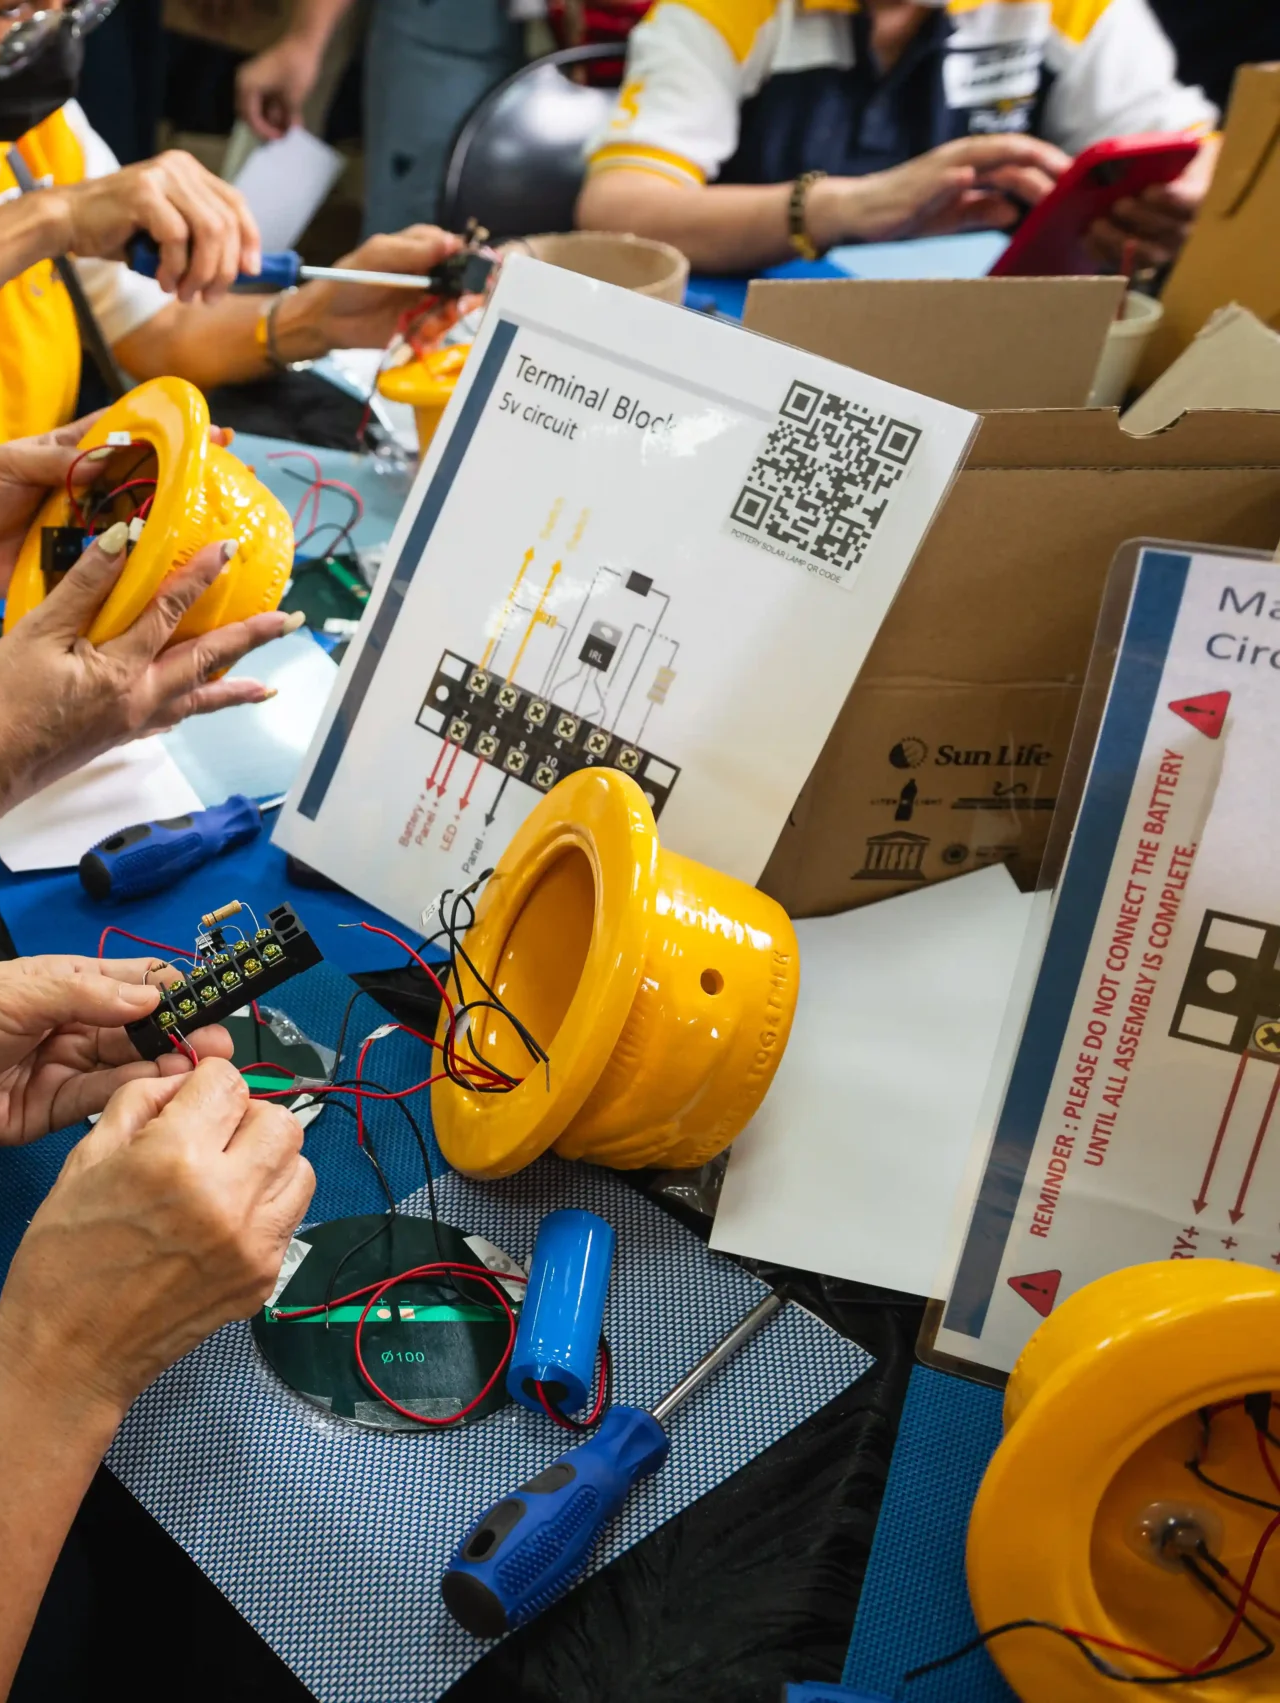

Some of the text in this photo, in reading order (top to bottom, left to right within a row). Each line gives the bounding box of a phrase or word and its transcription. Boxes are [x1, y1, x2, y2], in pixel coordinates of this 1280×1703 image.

[516, 353, 610, 412] Terminal
[498, 391, 579, 440] 5v circuit
[731, 528, 842, 583] POTTERY SOLAR LAMP QR CODE
[588, 648, 603, 663] IRL
[489, 725, 497, 735] 8
[496, 709, 505, 719] 2
[526, 724, 534, 734] 3
[519, 741, 527, 751] 9
[545, 755, 559, 767] 10
[554, 739, 562, 749] 4
[586, 755, 594, 765] 5
[935, 743, 1054, 767] Sun Life
[1143, 748, 1185, 836] BATTERY
[398, 804, 425, 848] Battery
[414, 810, 436, 846] Panel
[439, 823, 458, 852] LED
[461, 837, 484, 875] Panel
[1131, 839, 1160, 876] THE
[1106, 880, 1148, 972] CONNECT
[1084, 842, 1198, 1167] UNTIL ALL ASSEMBLY IS COMPLETE.
[1092, 974, 1122, 1017] NOT
[1083, 1020, 1108, 1051] DO
[1063, 1052, 1099, 1121] PLEASE
[1030, 1133, 1076, 1238] REMINDER
